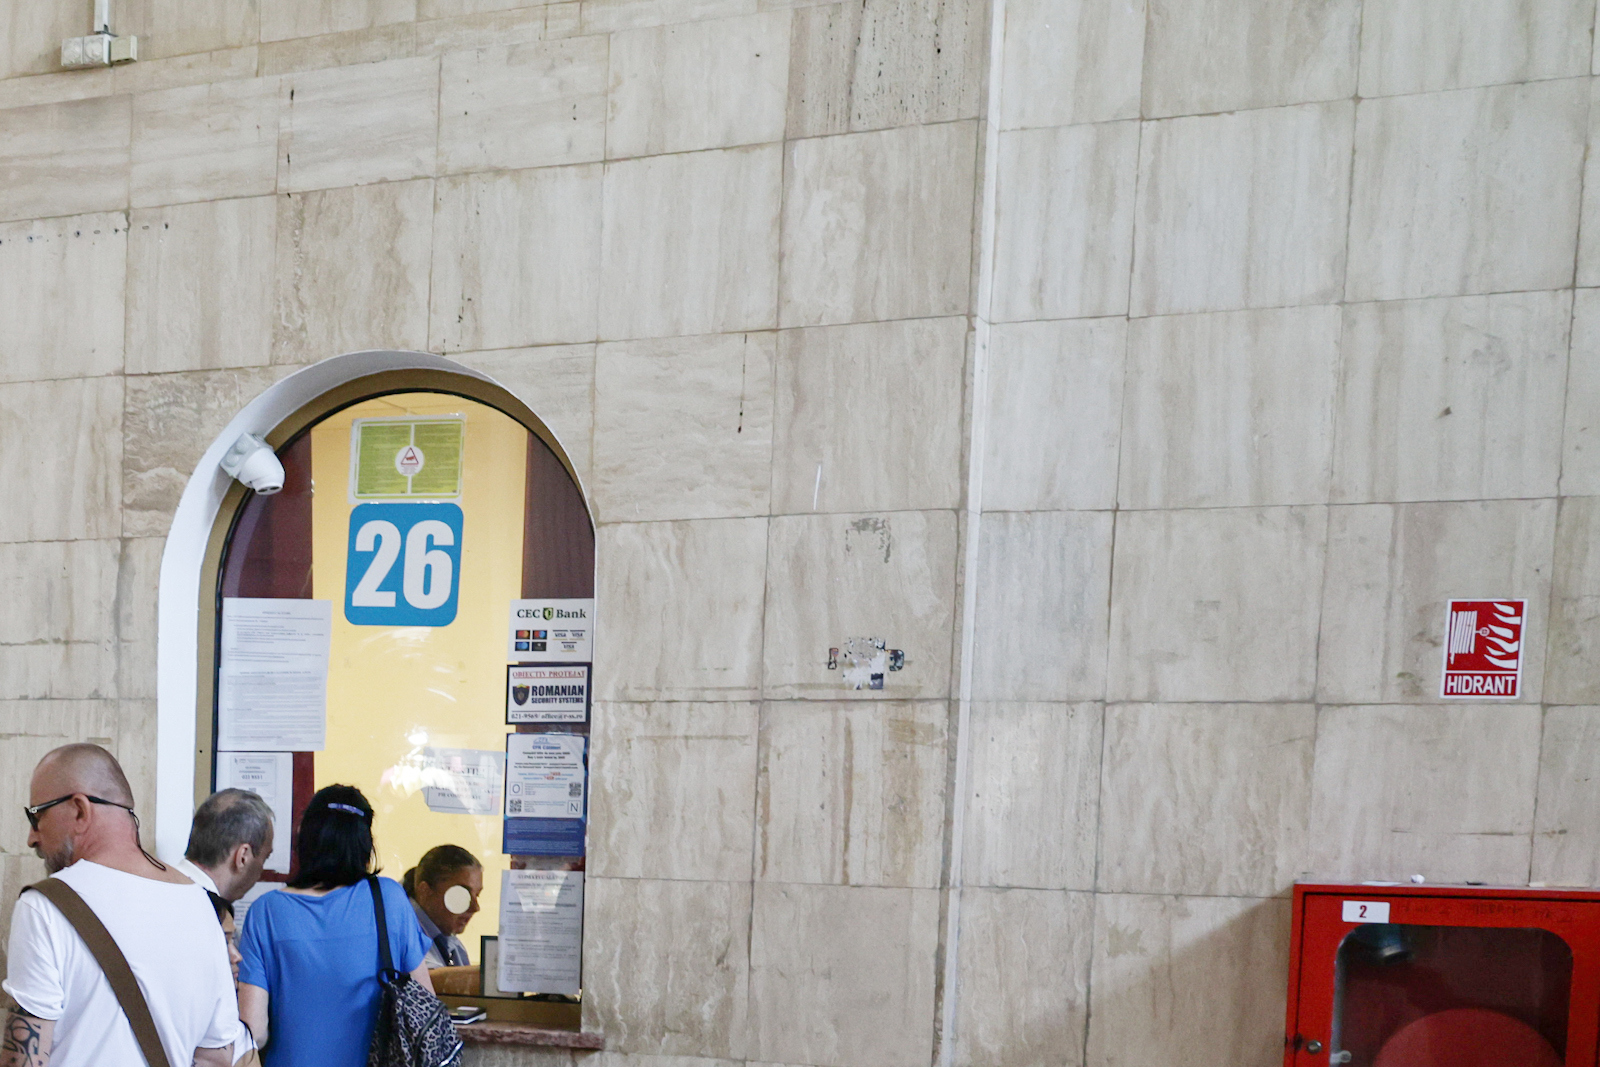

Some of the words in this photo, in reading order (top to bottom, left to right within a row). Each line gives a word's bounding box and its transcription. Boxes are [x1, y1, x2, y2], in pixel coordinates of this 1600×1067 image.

[352, 519, 454, 610] 26
[516, 608, 541, 619] CEC
[556, 608, 587, 619] Bank
[531, 684, 584, 696] ROMANIAN
[1446, 675, 1516, 694] HIDRANT
[570, 802, 579, 812] N
[1359, 904, 1367, 918] 2
